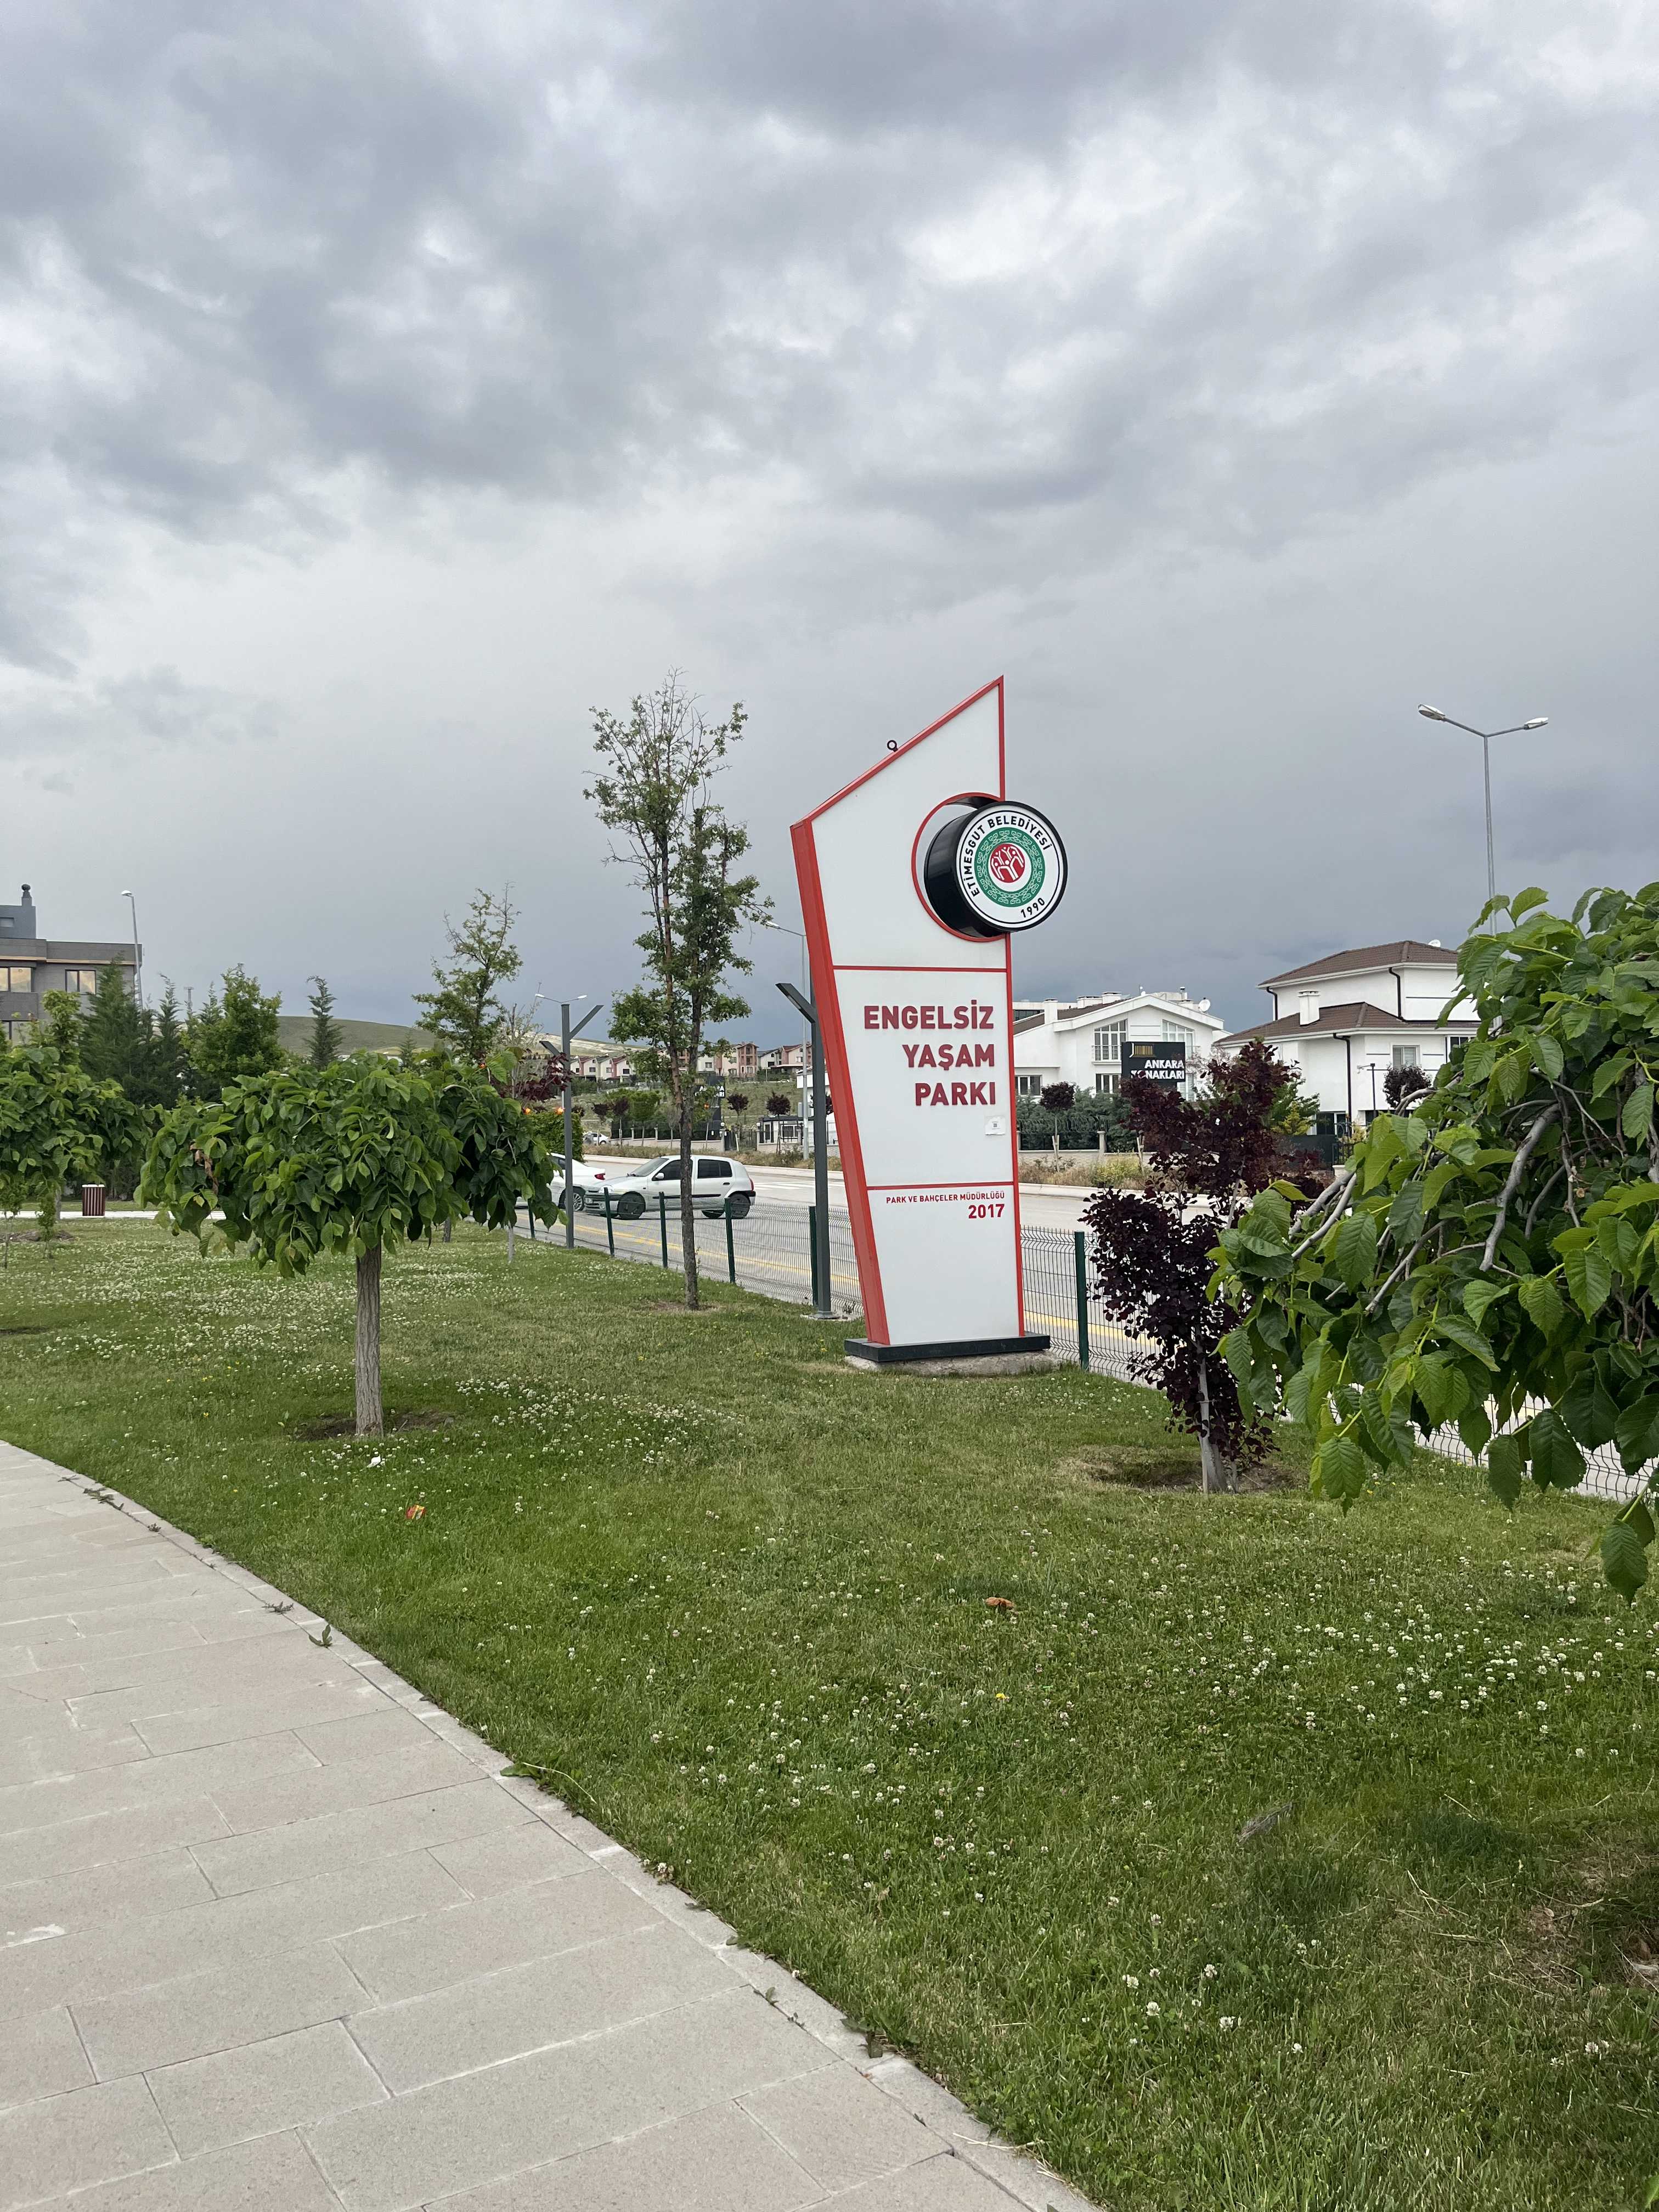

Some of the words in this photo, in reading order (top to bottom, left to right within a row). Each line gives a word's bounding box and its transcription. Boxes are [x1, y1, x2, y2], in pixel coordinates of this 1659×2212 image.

[964, 825, 985, 897] ETİMESGUT
[988, 815, 1053, 850] BELEDİYESİ
[1021, 898, 1045, 918] 1990
[864, 1000, 994, 1029] ENGELSİZ
[902, 1044, 995, 1071] YAŞAM
[1144, 1059, 1185, 1069] ANKARA
[915, 1082, 996, 1106] PARKI
[919, 1194, 958, 1202] BAHÇELER
[960, 1190, 1005, 1200] MÜDÜRLÜĞÜ
[968, 1204, 1005, 1219] 2017
